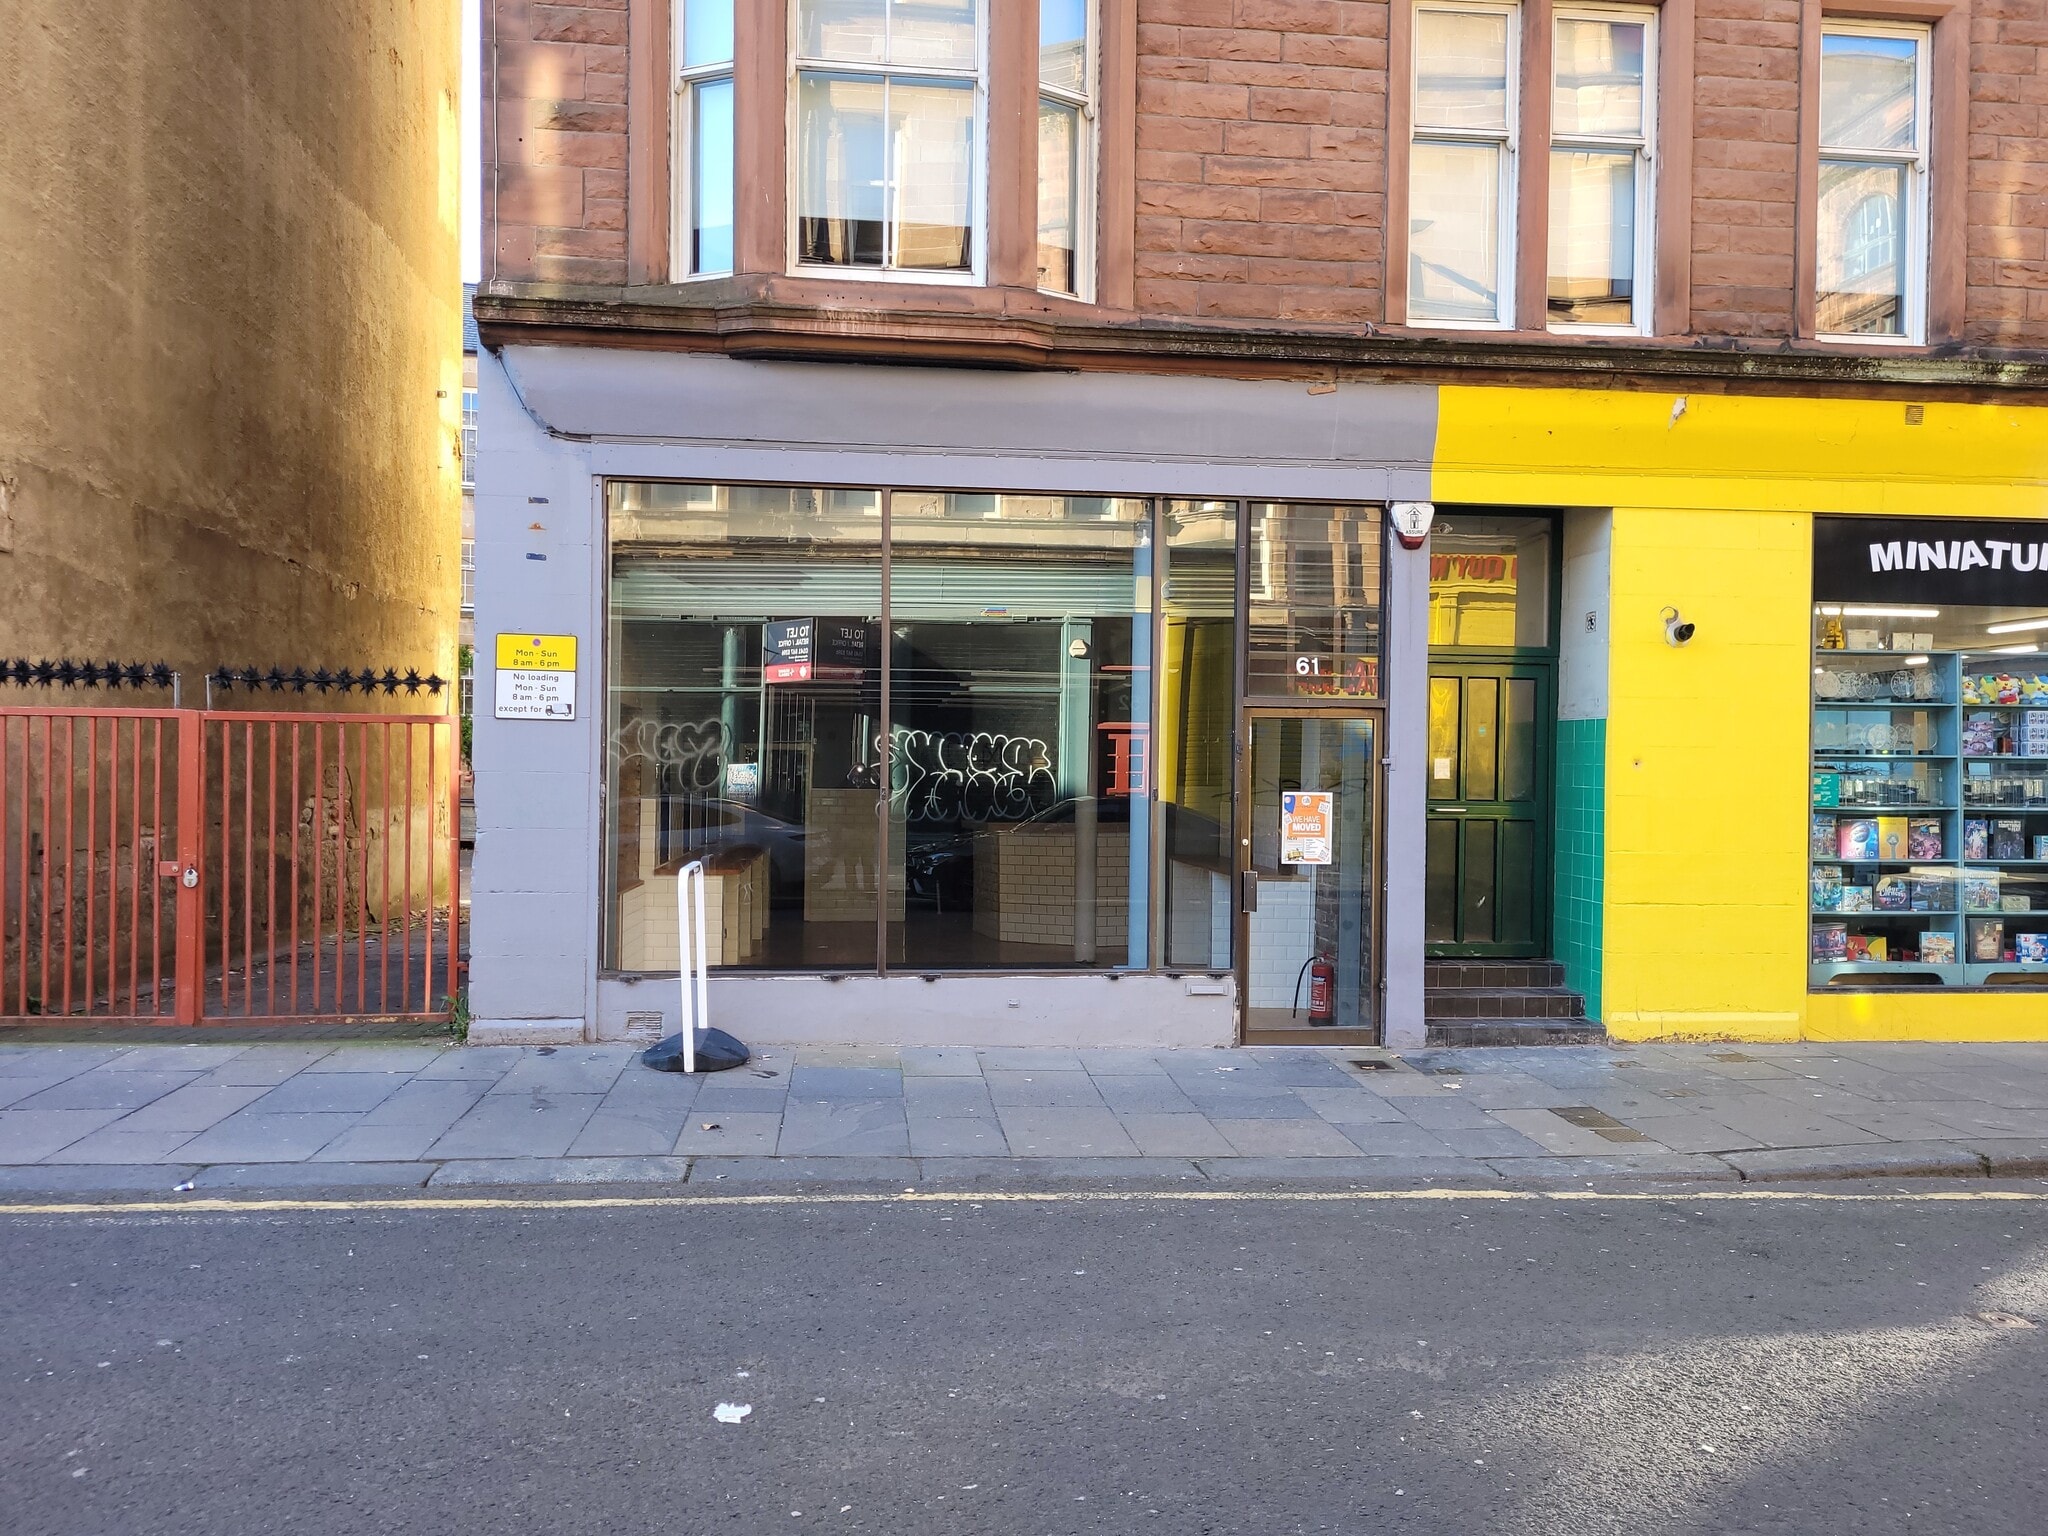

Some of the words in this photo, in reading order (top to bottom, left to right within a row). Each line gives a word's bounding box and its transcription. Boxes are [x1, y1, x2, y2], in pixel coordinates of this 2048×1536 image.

[1296, 657, 1319, 675] 61
[528, 674, 559, 682] loading
[1292, 823, 1321, 831] MOVED
